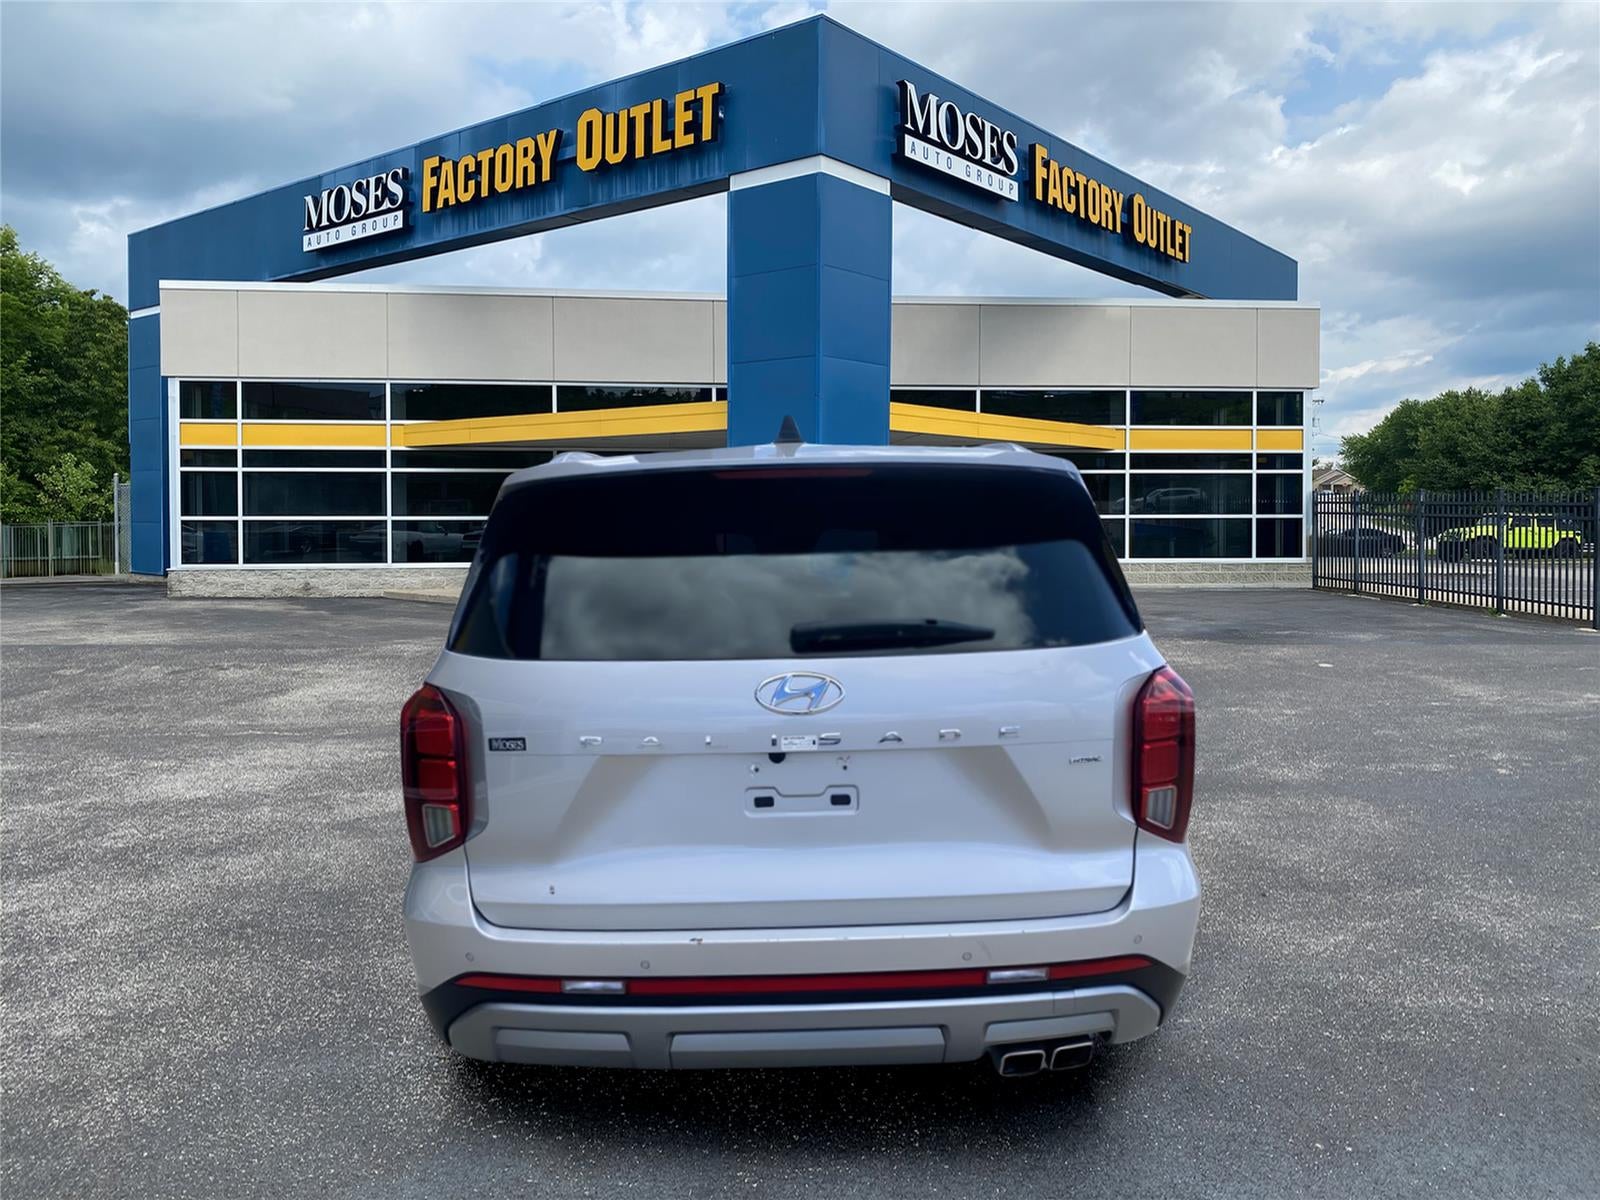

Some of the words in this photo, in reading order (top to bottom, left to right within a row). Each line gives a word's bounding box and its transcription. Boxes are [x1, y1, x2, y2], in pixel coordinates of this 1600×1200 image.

[422, 129, 558, 212] FACTORY
[576, 82, 720, 171] OUTLET
[903, 79, 1019, 176] MOSES
[303, 167, 404, 231] MOSES
[909, 141, 953, 170] AUTO
[964, 163, 1016, 195] GROUP
[1035, 143, 1124, 234] FACTORY
[1132, 192, 1192, 263] OUTLET
[306, 229, 341, 248] AUTO
[350, 214, 399, 236] GROUP
